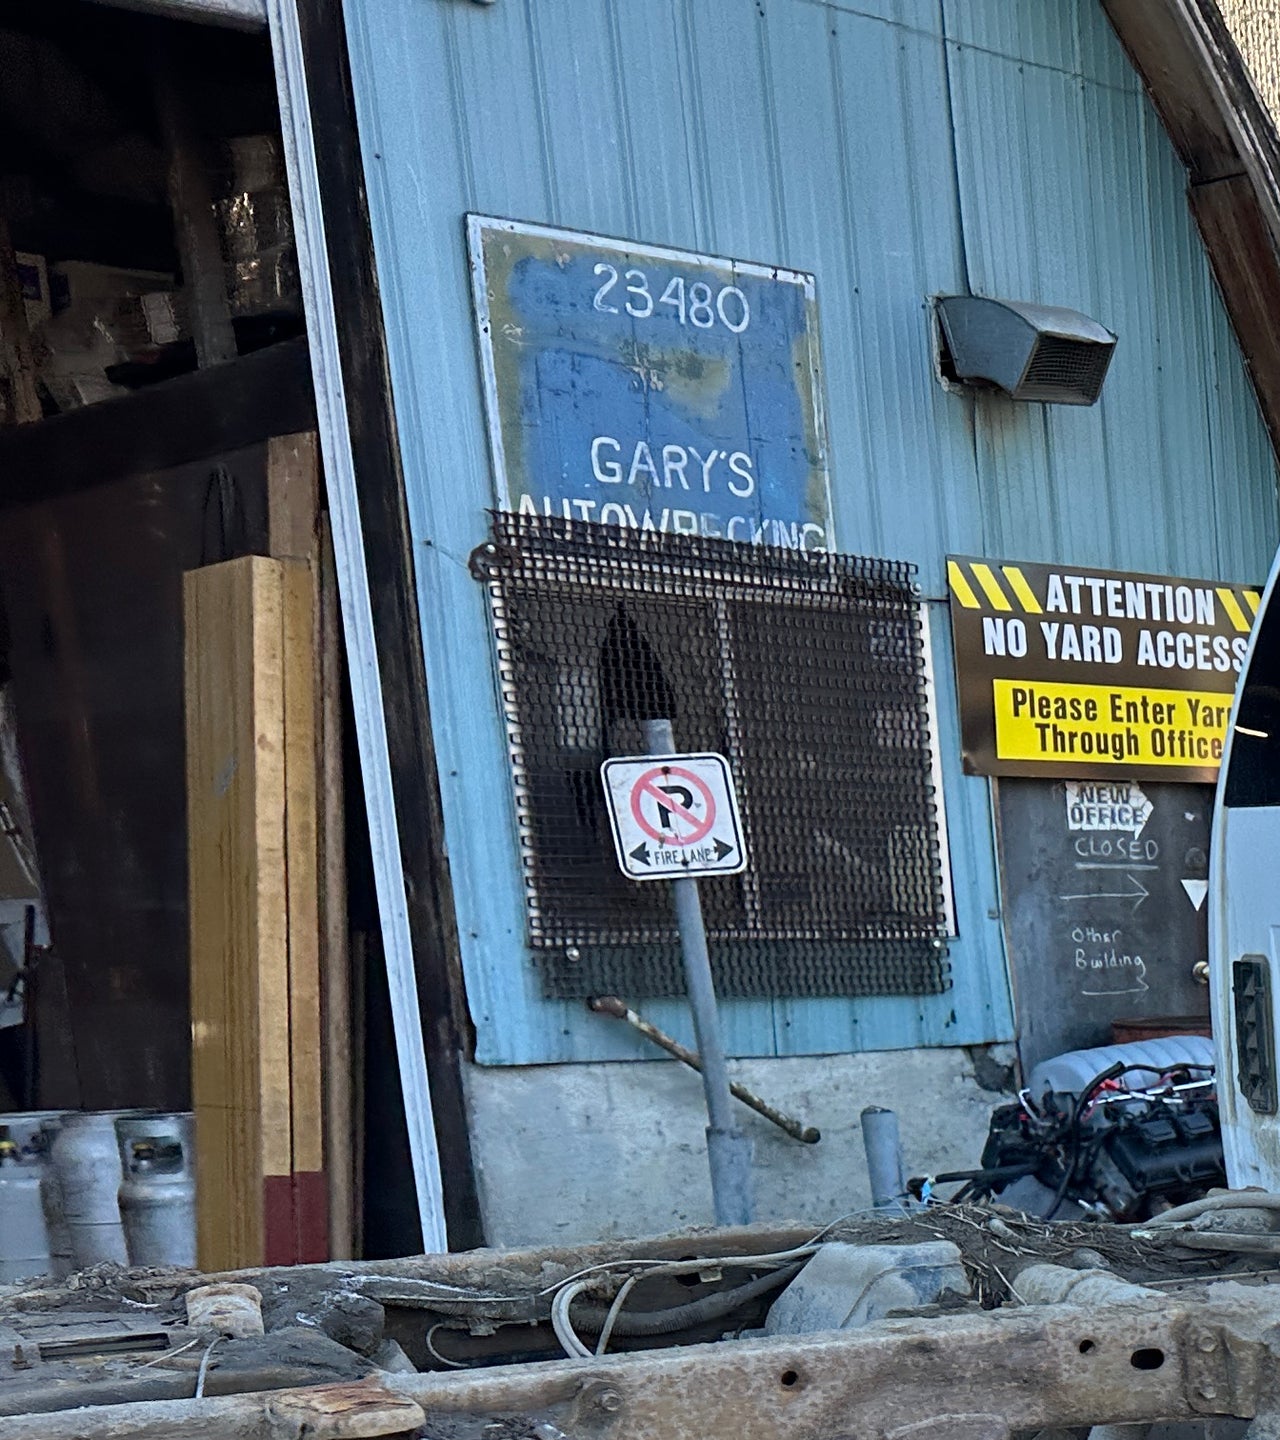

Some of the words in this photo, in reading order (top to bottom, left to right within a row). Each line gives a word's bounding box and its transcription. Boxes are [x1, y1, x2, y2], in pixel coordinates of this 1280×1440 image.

[593, 263, 750, 333] 23480
[590, 436, 755, 498] GARY'S
[1046, 573, 1216, 626] ATTENTION
[982, 616, 1028, 658] NO
[1040, 621, 1123, 664] YARD
[1137, 629, 1251, 673] ACCESS
[1012, 687, 1098, 722] Please
[1110, 693, 1176, 725] Enter
[1035, 722, 1140, 761] Through
[1151, 728, 1223, 760] Office
[1080, 785, 1130, 805] NEW
[1070, 805, 1146, 826] OFFICE
[654, 849, 680, 866] FIRE
[1075, 836, 1159, 860] CLOSED
[1075, 948, 1147, 977] Building
